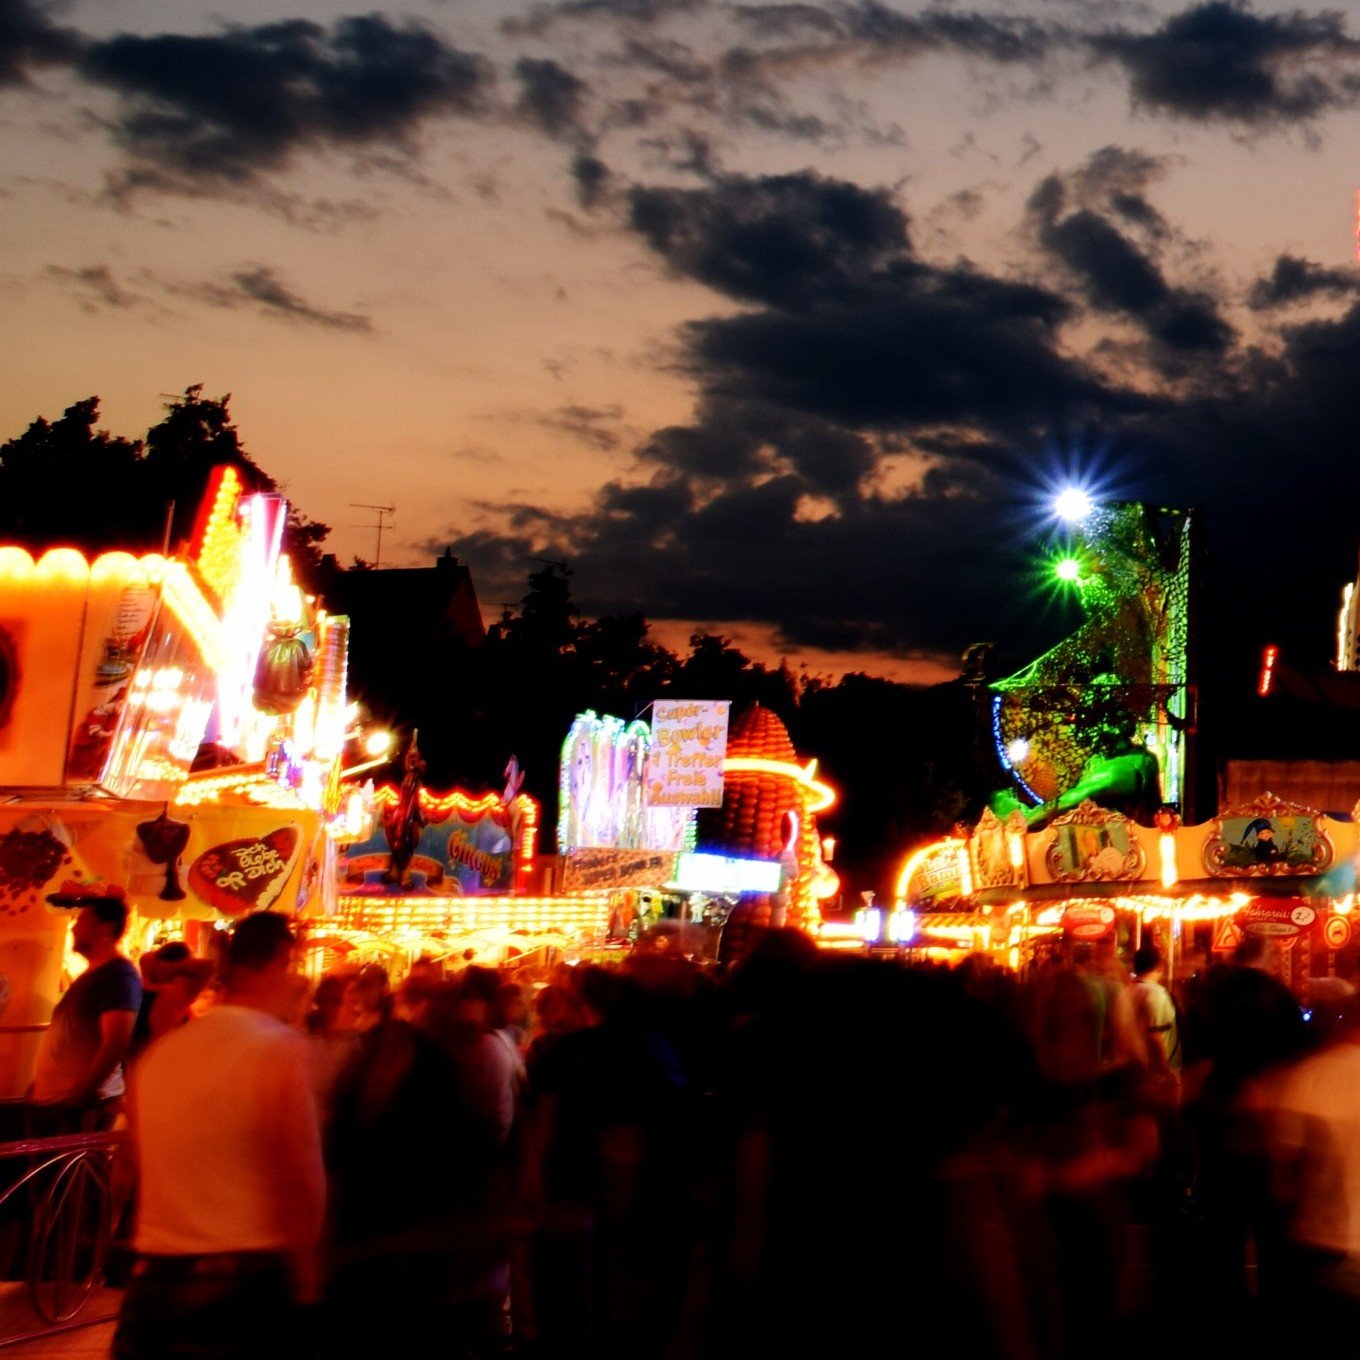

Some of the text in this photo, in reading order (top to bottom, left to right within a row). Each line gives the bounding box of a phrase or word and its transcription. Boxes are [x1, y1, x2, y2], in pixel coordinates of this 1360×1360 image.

[655, 703, 709, 723] Super-
[656, 722, 725, 747] Bowler
[666, 750, 722, 769] Treffer
[666, 769, 707, 786] Freie
[244, 859, 287, 879] Dich
